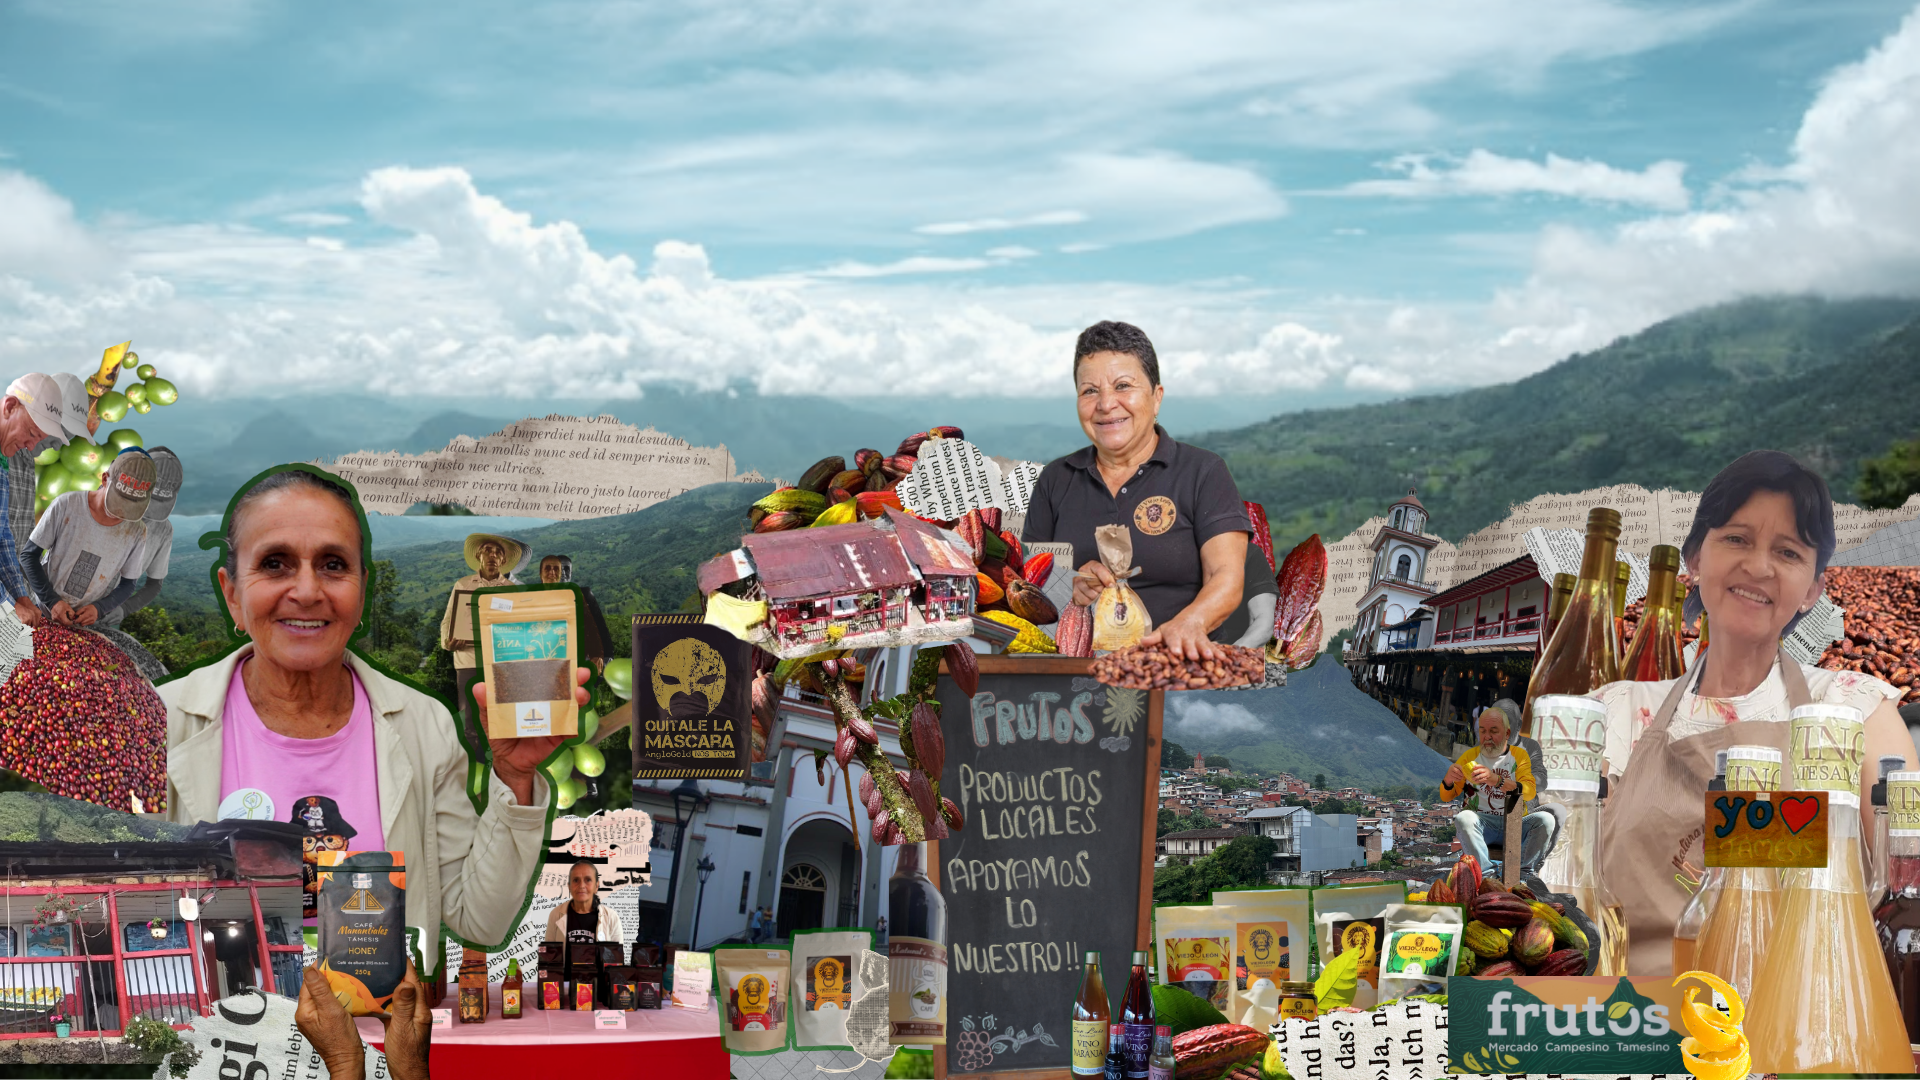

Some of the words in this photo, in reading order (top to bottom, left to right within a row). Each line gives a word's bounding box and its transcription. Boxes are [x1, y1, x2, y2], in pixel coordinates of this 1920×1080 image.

[511, 425, 574, 442] Imperdiet
[578, 430, 611, 443] nulla
[472, 441, 488, 454] In
[491, 443, 530, 457] mollis
[533, 448, 566, 459] nunc
[568, 447, 591, 460] sed
[593, 448, 607, 461] id
[608, 452, 655, 466] semper
[657, 451, 691, 464] risus
[693, 453, 711, 466] in.
[342, 456, 379, 470] neque
[383, 455, 428, 469] viverra
[430, 458, 465, 473] justo
[468, 461, 490, 472] nec
[494, 460, 545, 475] ultrices.
[116, 481, 132, 496] QUE
[356, 474, 420, 490] consequat
[422, 479, 469, 492] semper
[471, 478, 518, 492] viverra
[521, 483, 550, 494] nam
[553, 481, 590, 496] libero
[590, 484, 625, 499] justo
[976, 469, 994, 504] unfair
[362, 492, 421, 504] convallis
[464, 495, 478, 508] id
[481, 497, 541, 511] interdum
[546, 500, 575, 513] velit
[578, 501, 622, 515] laoreet
[645, 717, 708, 732] QUÍTALE
[713, 719, 735, 732] LA
[970, 691, 1095, 747] FRUTOS
[644, 731, 735, 749] MÁSCARA
[644, 750, 692, 760] AngloGold
[959, 763, 1102, 808] PRODUCTOS
[948, 850, 1091, 894] APOYAMOS
[1006, 896, 1037, 928] LO
[348, 947, 377, 955] HONEY
[1202, 951, 1219, 959] LEÓN
[1487, 990, 1670, 1037] frutos
[1073, 1048, 1104, 1058] NARANJA
[1125, 1043, 1148, 1051] VINO
[1332, 1019, 1356, 1069] das?
[1489, 1042, 1538, 1053] Mercado
[1545, 1042, 1610, 1054] Campesino
[1616, 1042, 1670, 1053] Tamesino
